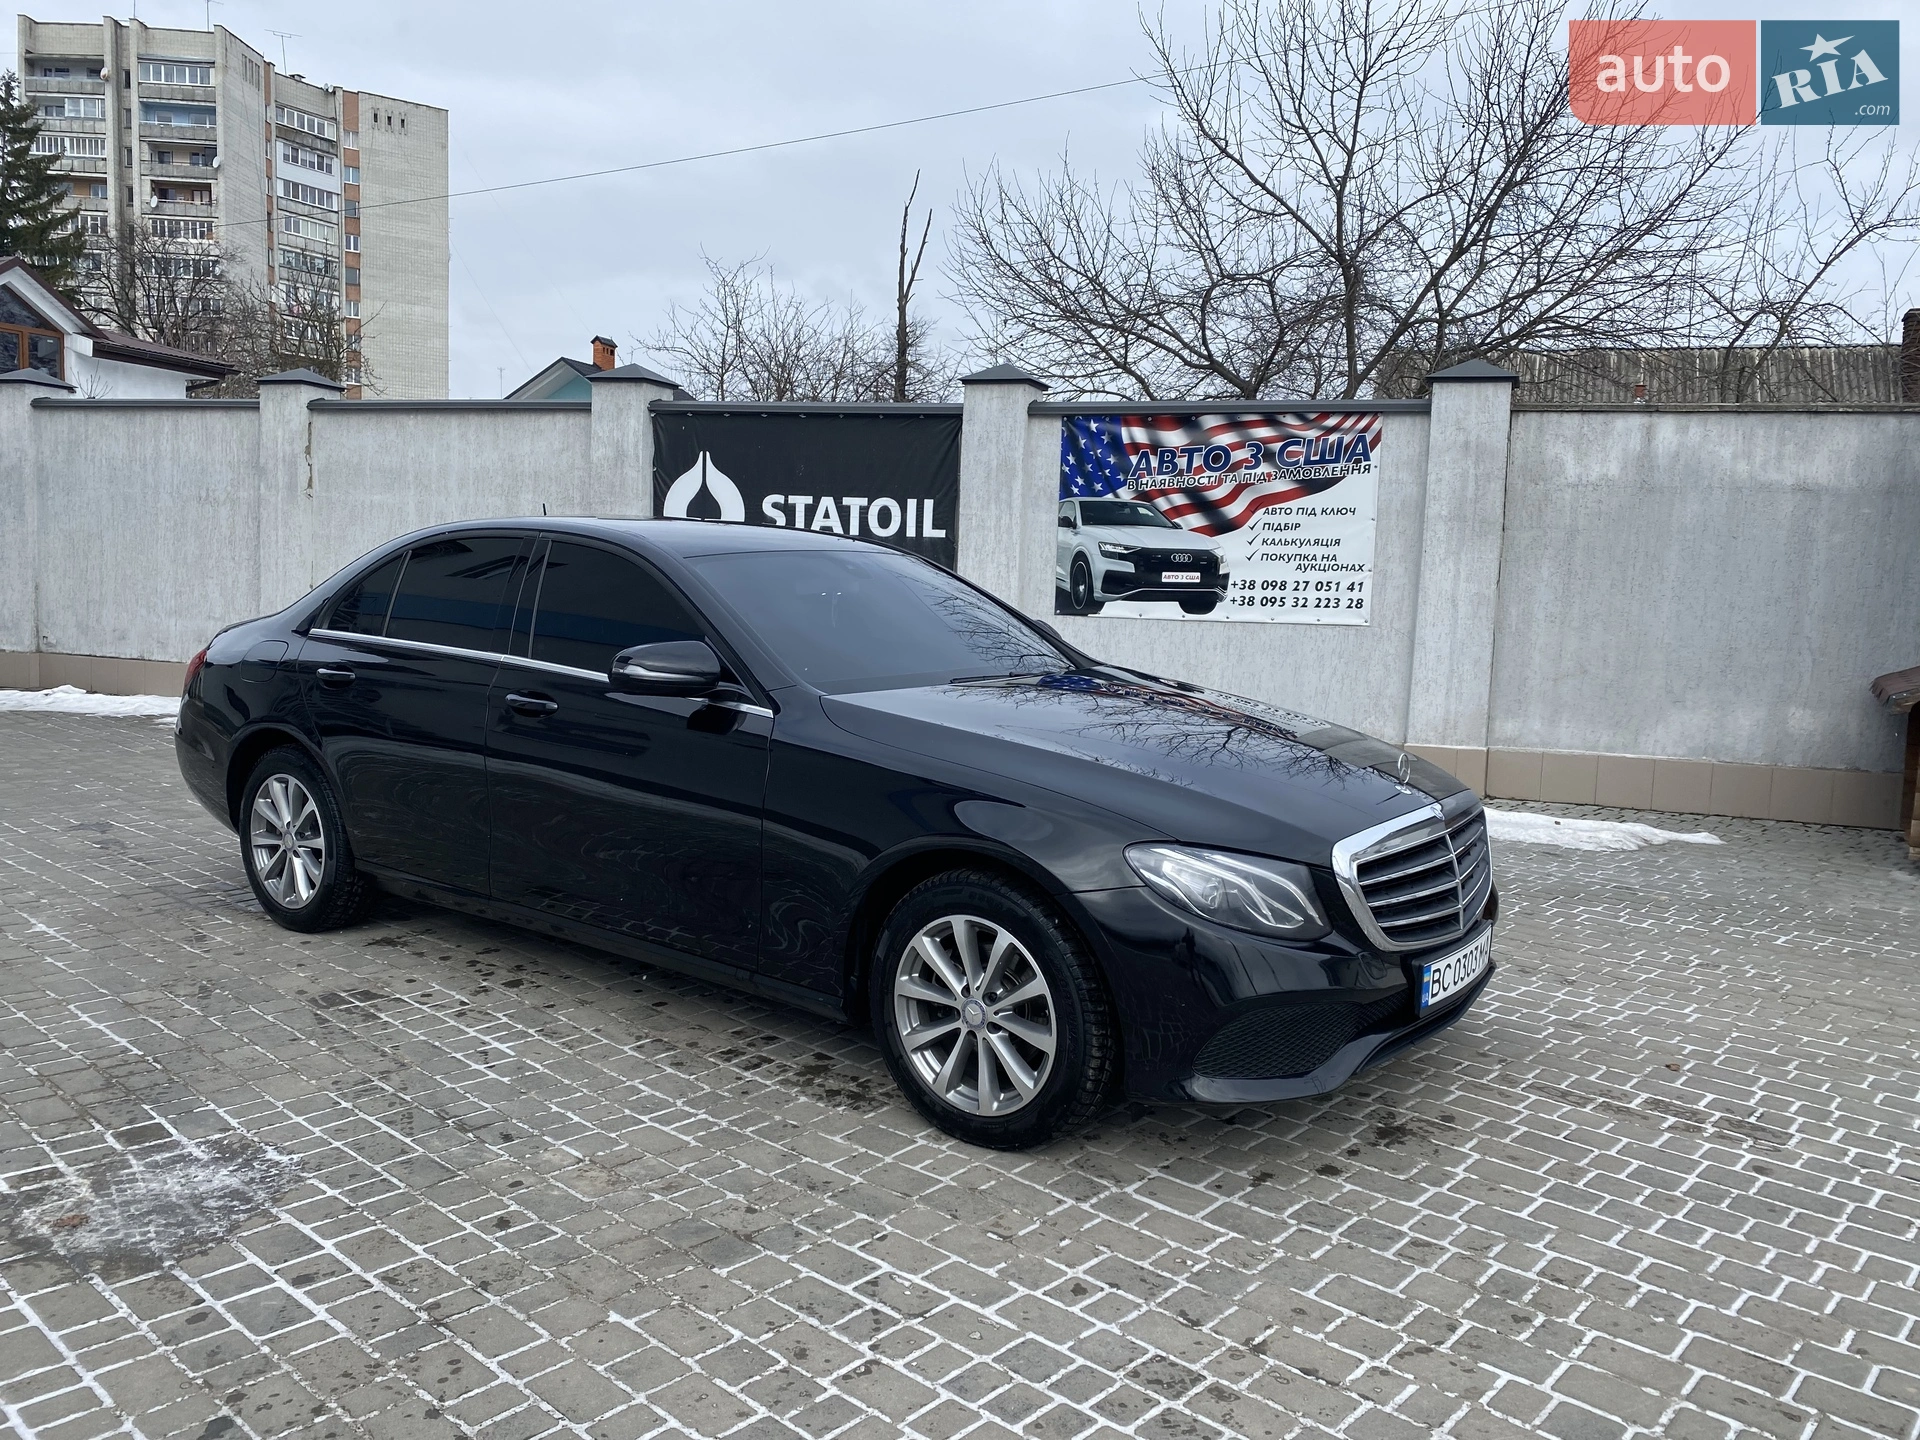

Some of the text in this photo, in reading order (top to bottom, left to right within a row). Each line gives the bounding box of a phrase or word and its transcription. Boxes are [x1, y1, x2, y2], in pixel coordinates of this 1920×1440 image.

[1130, 444, 1232, 479] АВТО
[1277, 433, 1372, 470] США
[1128, 463, 1371, 491] В НАЯВНОСТІ ТА ПІД ЗАМОВЛЕННЯ
[761, 493, 947, 538] STATOIL
[1263, 507, 1356, 517] АВТО ПІД КЛЮЧ
[1262, 522, 1301, 532] ПІДБІР
[1261, 537, 1341, 548] КАЛЬКУЛЯЦІЯ
[1260, 553, 1338, 564] ПОКУПКА НА
[1295, 563, 1366, 573] АУКЦІОНАХ
[1230, 579, 1364, 593] +38 098 27 051 41
[1229, 595, 1364, 610] +38 095 32 223 28
